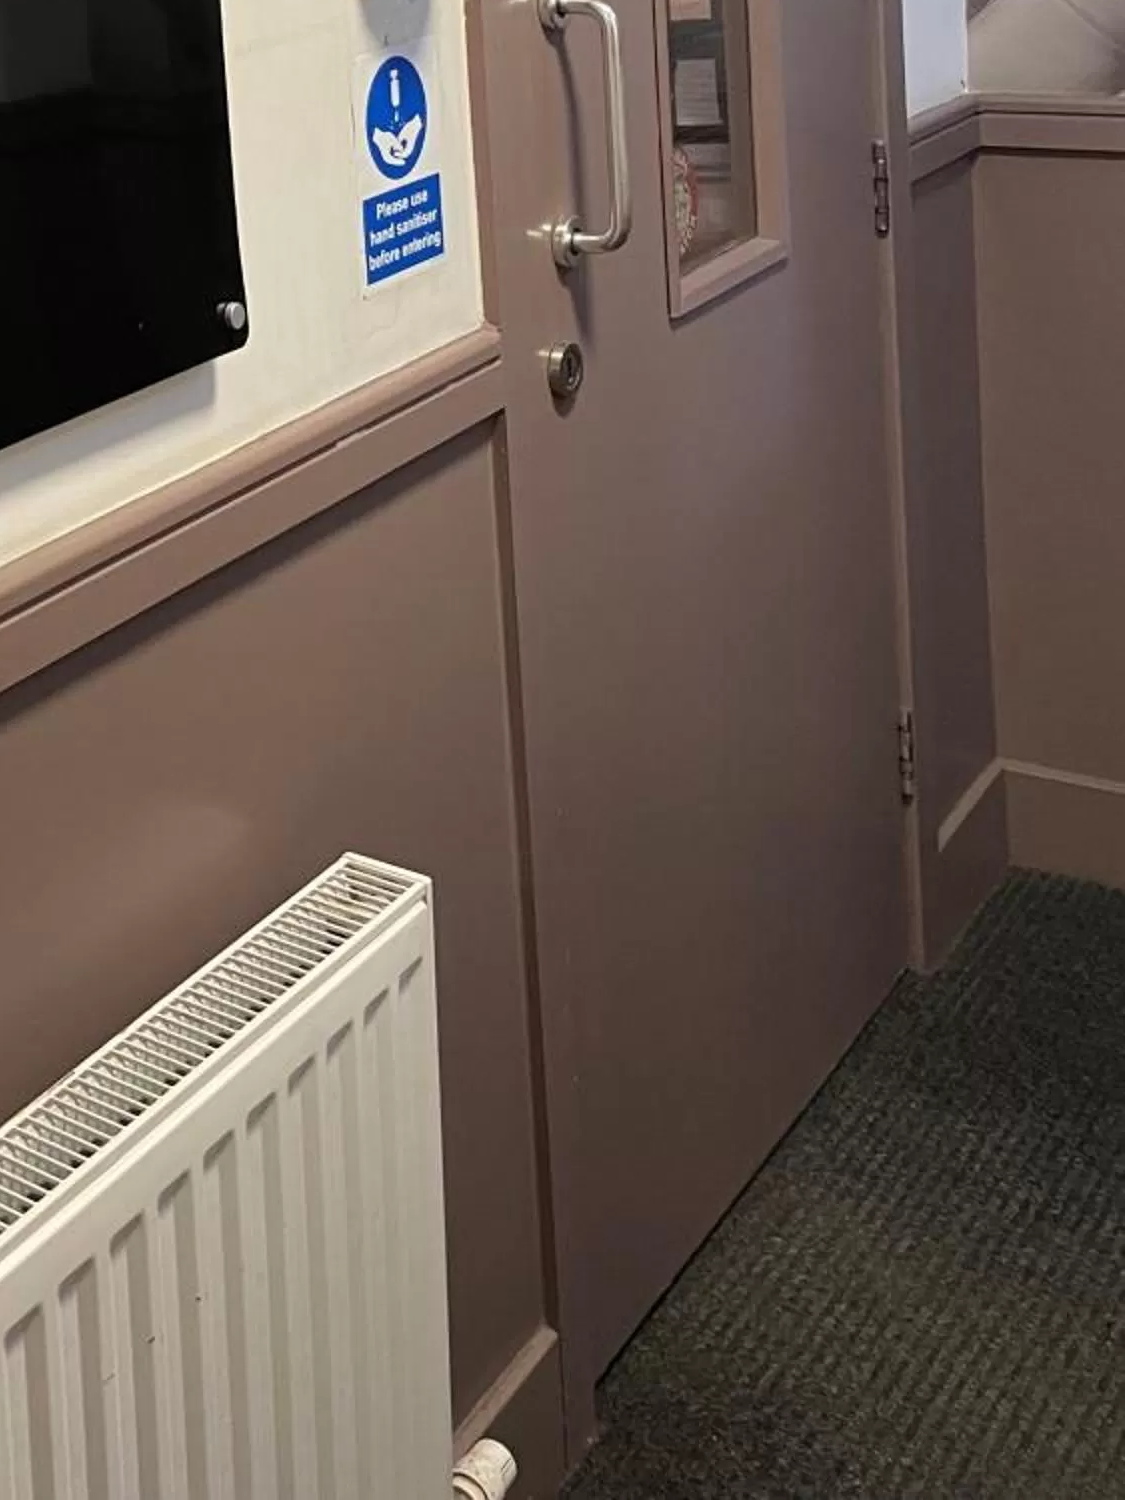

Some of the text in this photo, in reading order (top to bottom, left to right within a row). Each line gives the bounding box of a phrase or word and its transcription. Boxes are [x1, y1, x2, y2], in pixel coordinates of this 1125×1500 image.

[376, 189, 428, 220] Please use
[370, 208, 437, 247] hand sanitiser
[369, 231, 442, 271] before entering
